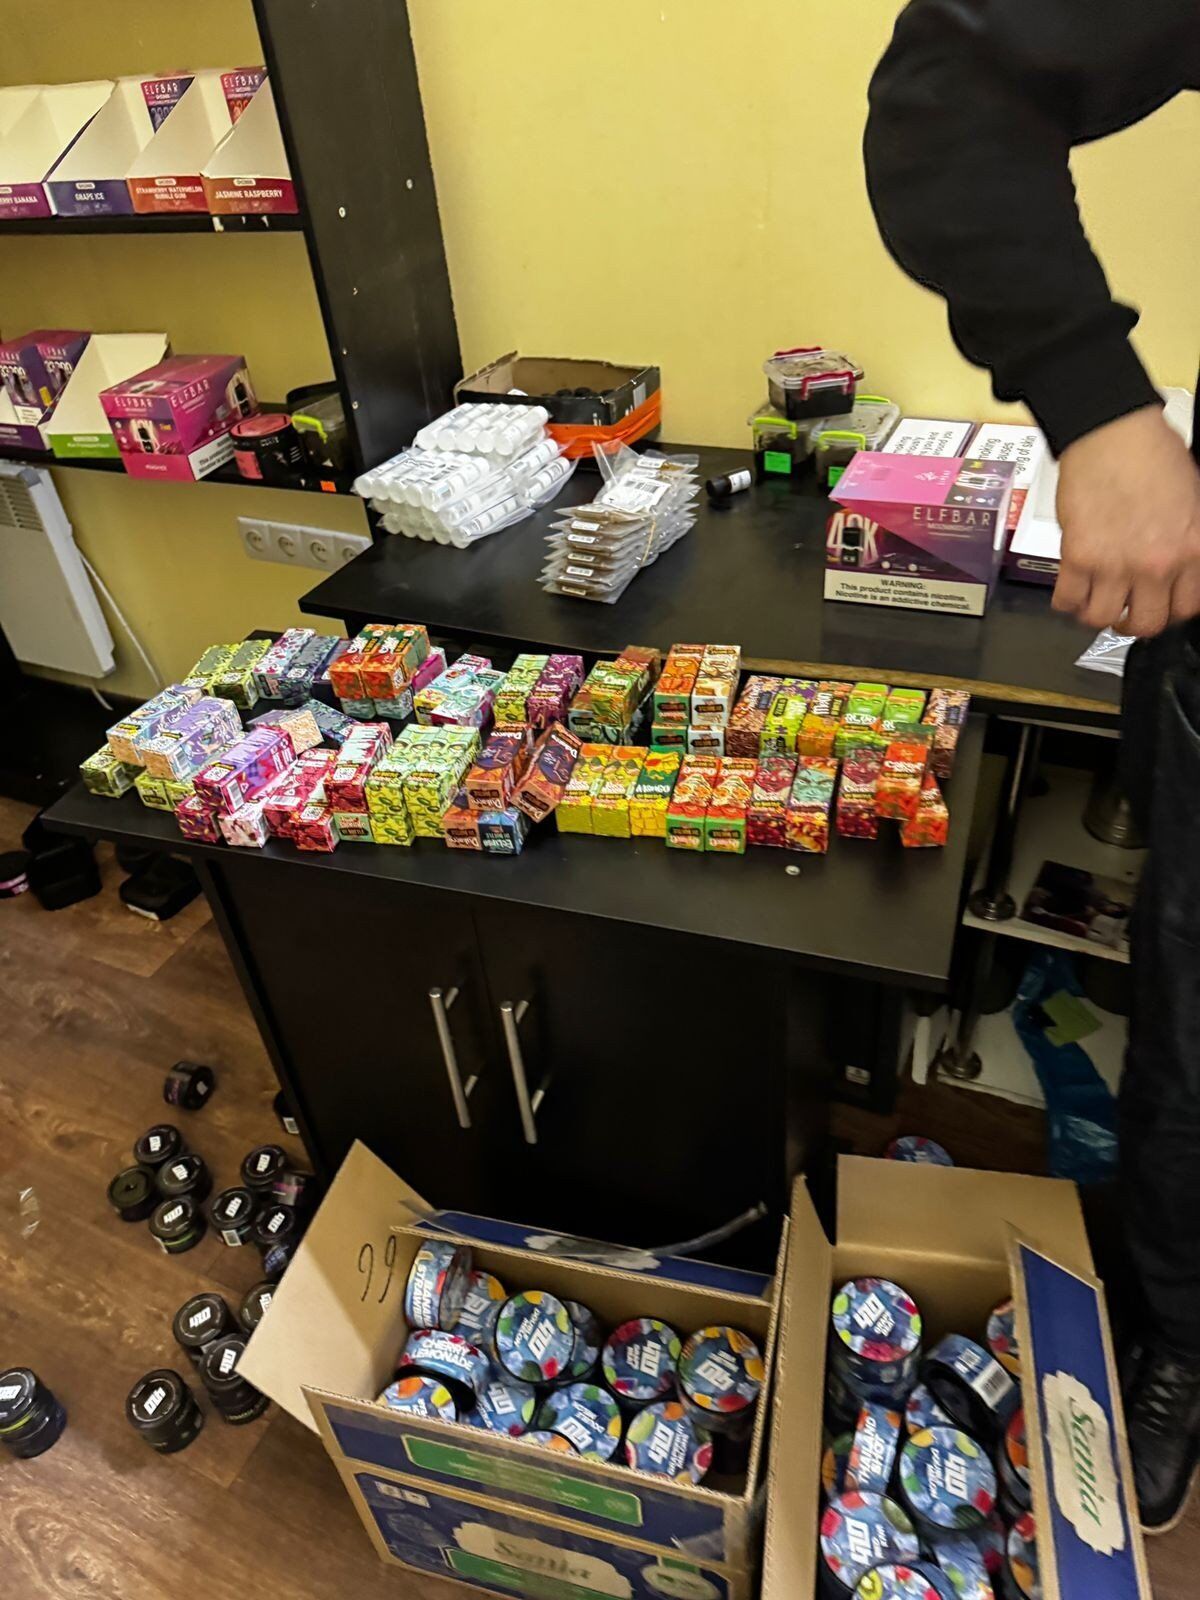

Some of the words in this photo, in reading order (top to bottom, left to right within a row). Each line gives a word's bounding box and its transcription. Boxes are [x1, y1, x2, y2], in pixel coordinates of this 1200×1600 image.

[224, 75, 260, 88] ELFBAR
[144, 83, 178, 95] ELFBAR
[75, 193, 94, 201] GRAPE
[95, 192, 105, 200] ICE
[215, 190, 243, 199] JASMINE
[244, 189, 283, 198] RASPBERRY
[170, 379, 210, 407] ELFBAR
[115, 397, 153, 408] ELFBAR
[913, 506, 991, 526] ELFBAR
[881, 579, 926, 590] WARNING:
[835, 590, 868, 600] Nicotine
[879, 594, 890, 602] an
[891, 595, 929, 606] addictive
[840, 583, 858, 591] This
[859, 585, 892, 595] product
[893, 588, 929, 598] contains
[931, 592, 966, 602] nicotine.
[421, 1337, 471, 1357] CHERRY
[411, 1348, 475, 1371] LEMONADE
